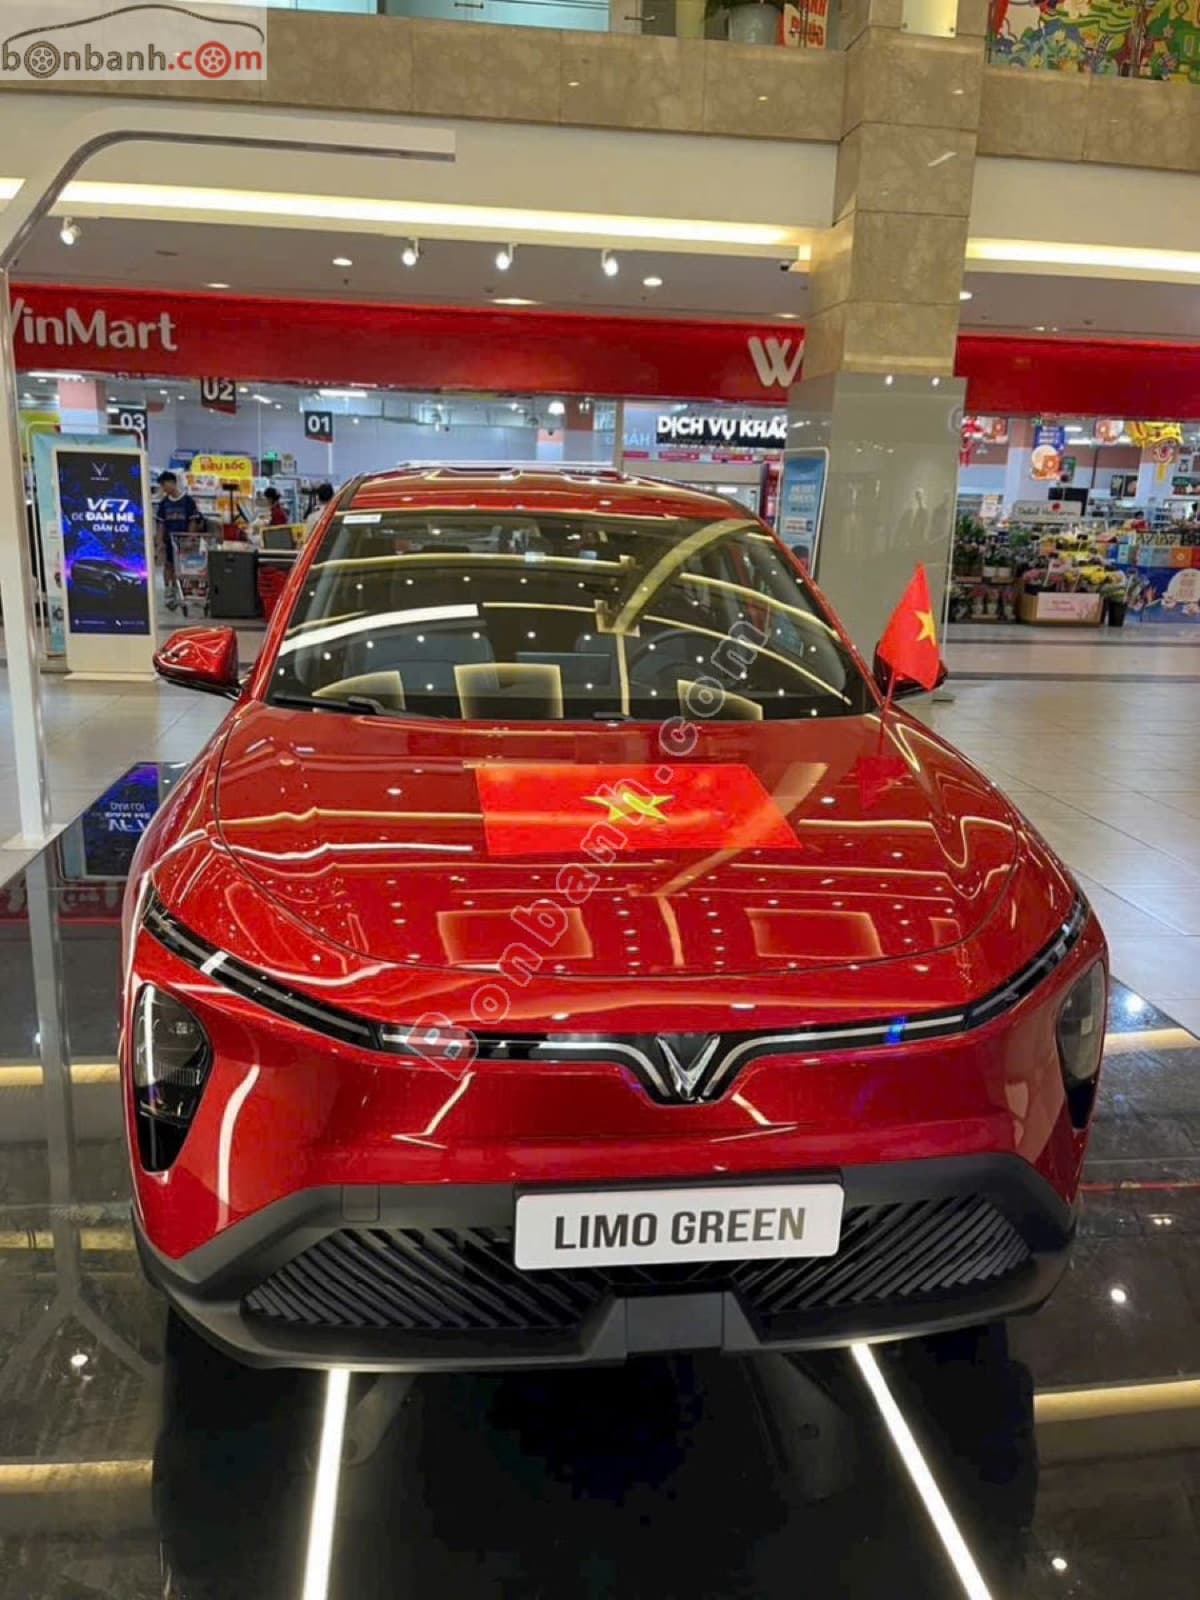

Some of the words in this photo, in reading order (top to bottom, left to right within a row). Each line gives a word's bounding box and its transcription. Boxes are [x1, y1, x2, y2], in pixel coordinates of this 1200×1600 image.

[120, 414, 145, 431] 03
[308, 415, 329, 432] 01
[658, 415, 704, 437] DỊCH
[708, 418, 736, 440] VỤ
[87, 498, 129, 512] VF7
[554, 1213, 657, 1250] LIMO
[671, 1207, 806, 1246] GREEN
